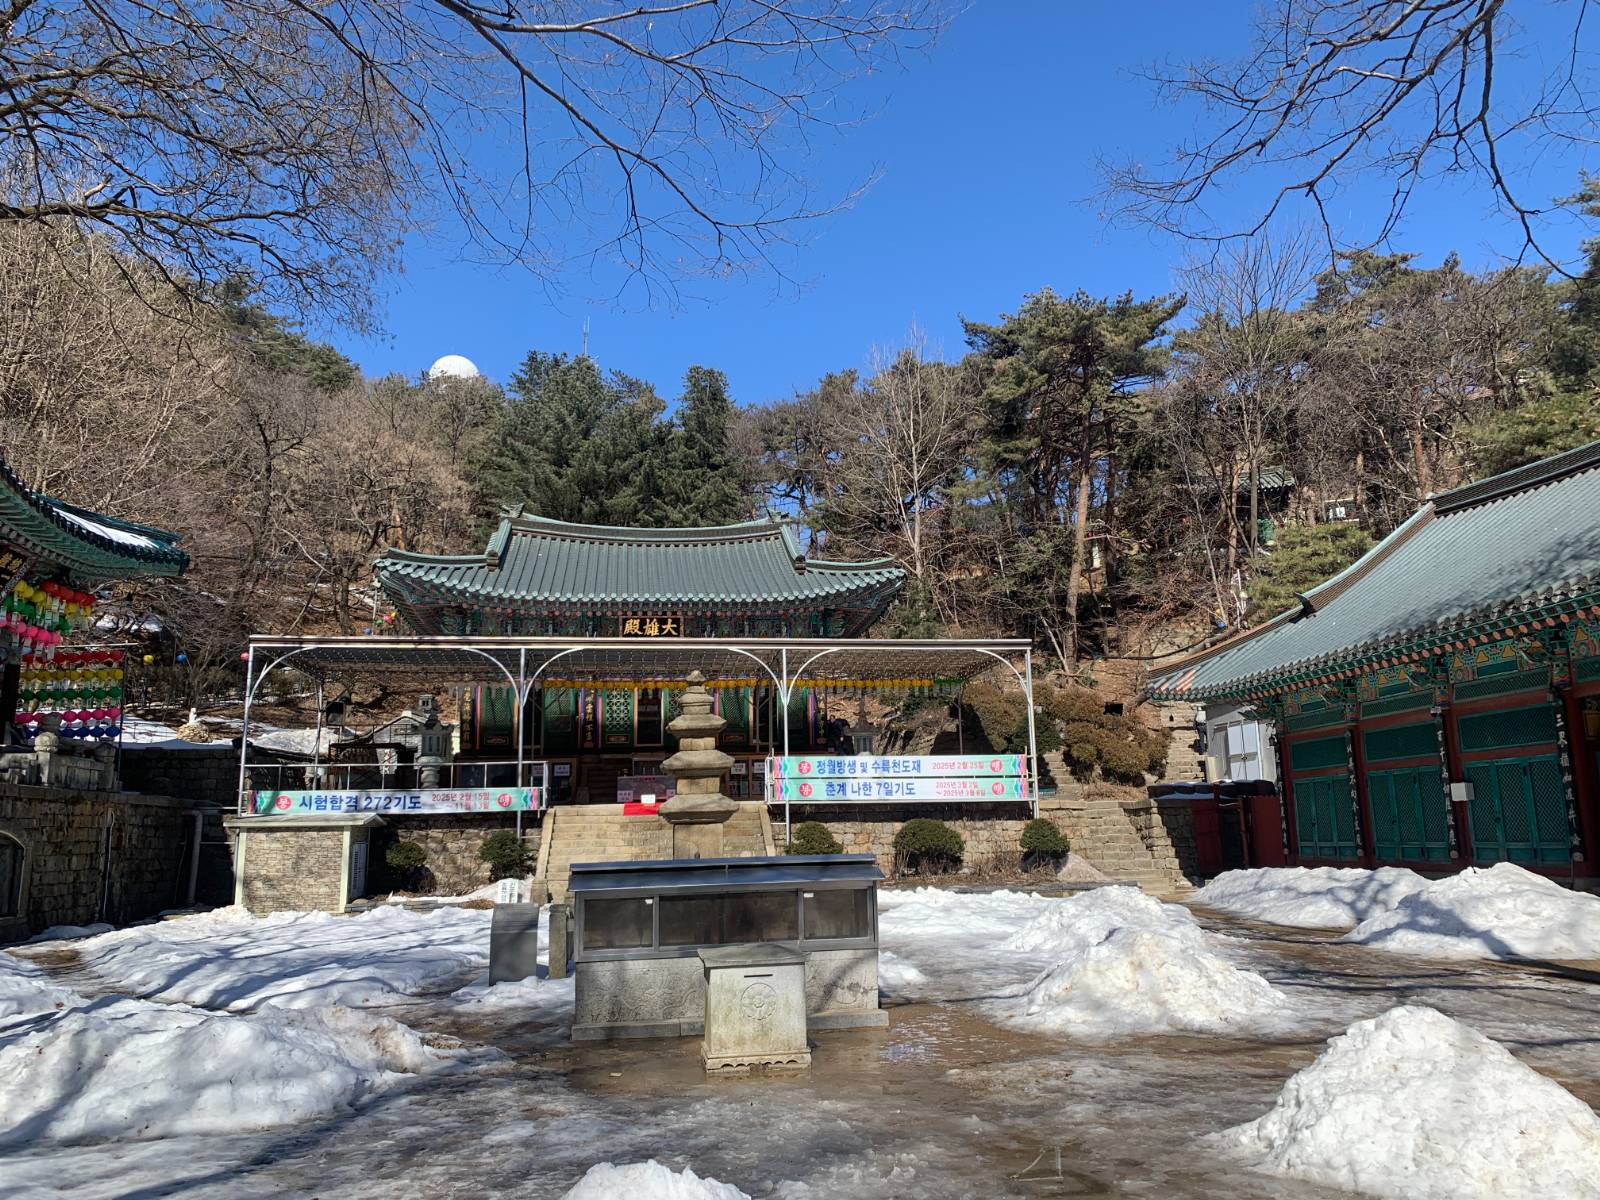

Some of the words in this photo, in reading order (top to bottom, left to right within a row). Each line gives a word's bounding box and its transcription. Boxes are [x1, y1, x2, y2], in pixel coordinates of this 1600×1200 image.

[817, 760, 856, 774] 정월방생
[860, 762, 867, 772] 및
[871, 759, 921, 774] 수륙천도재
[932, 762, 955, 770] 2025년
[825, 782, 846, 796] 춘계
[850, 782, 872, 796] 나한
[876, 782, 916, 796] 7일기도
[299, 795, 358, 810] 시험합격
[364, 794, 421, 809] 272기도
[432, 793, 458, 802] 2025년
